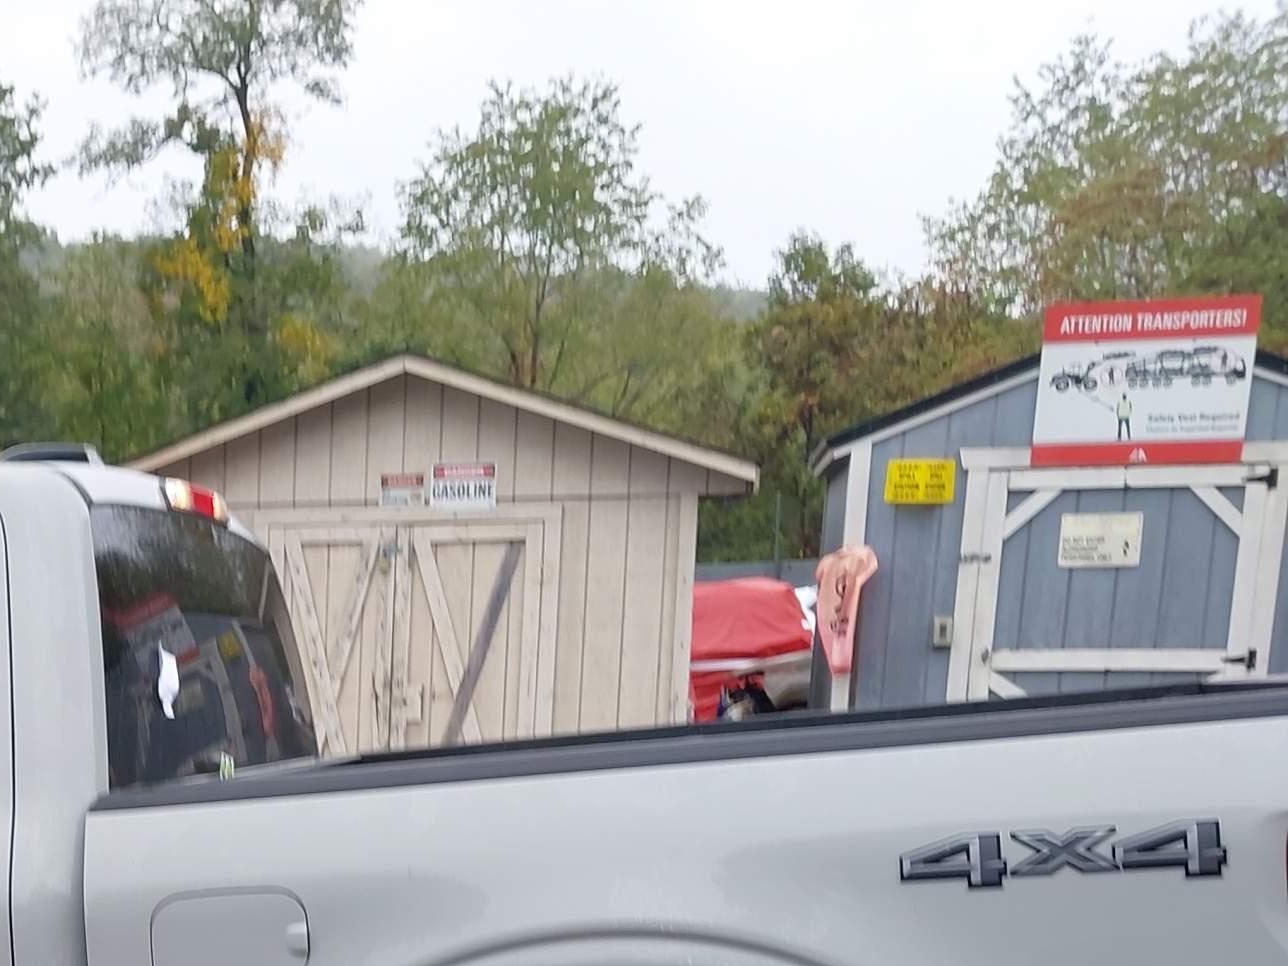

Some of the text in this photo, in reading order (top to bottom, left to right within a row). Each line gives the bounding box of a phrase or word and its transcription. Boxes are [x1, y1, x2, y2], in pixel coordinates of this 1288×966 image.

[1060, 308, 1247, 335] ATTENTION TRANSPORTERS!
[432, 481, 492, 499] GASOLINE
